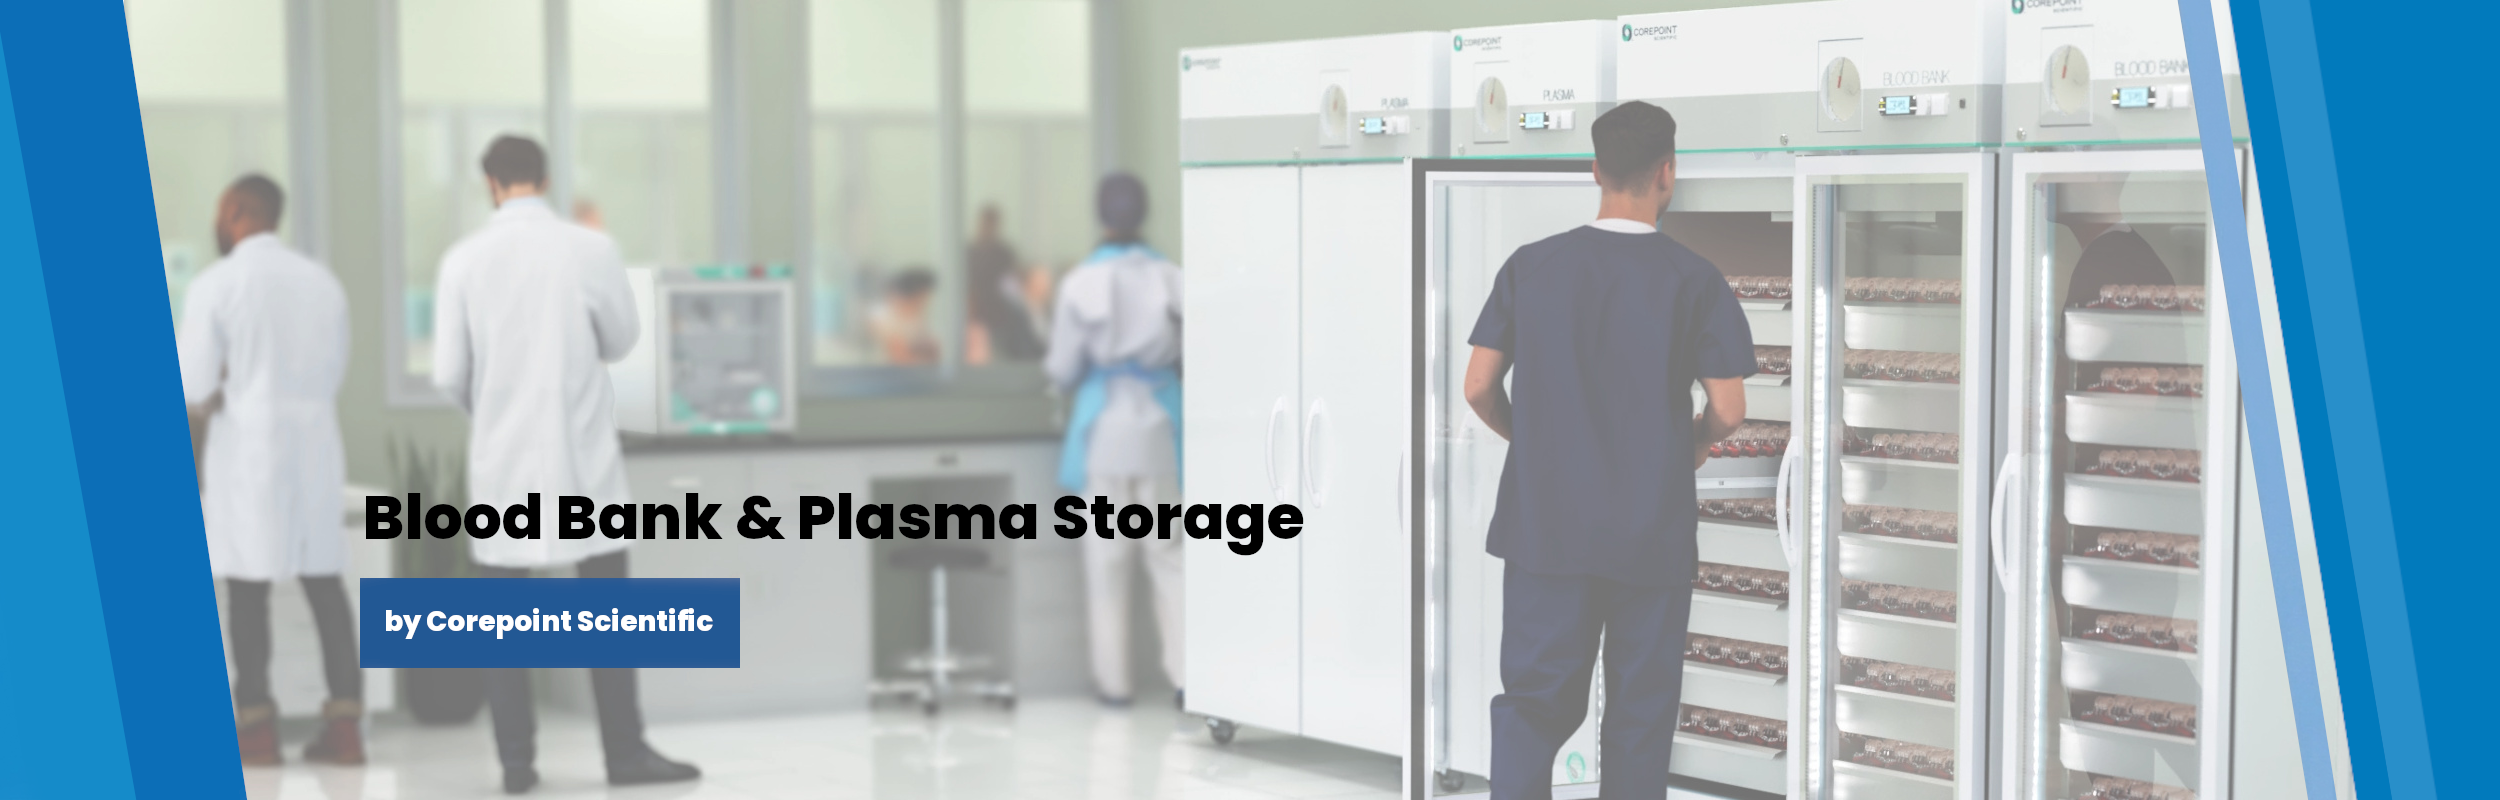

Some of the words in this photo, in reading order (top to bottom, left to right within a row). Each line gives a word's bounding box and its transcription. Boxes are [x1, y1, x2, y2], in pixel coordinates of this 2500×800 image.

[1633, 25, 1678, 37] COREPOINT
[2114, 60, 2156, 77] BLOOD
[1883, 71, 1919, 87] BLOOD
[1922, 69, 1950, 85] BANK
[1543, 88, 1575, 102] PLASMA
